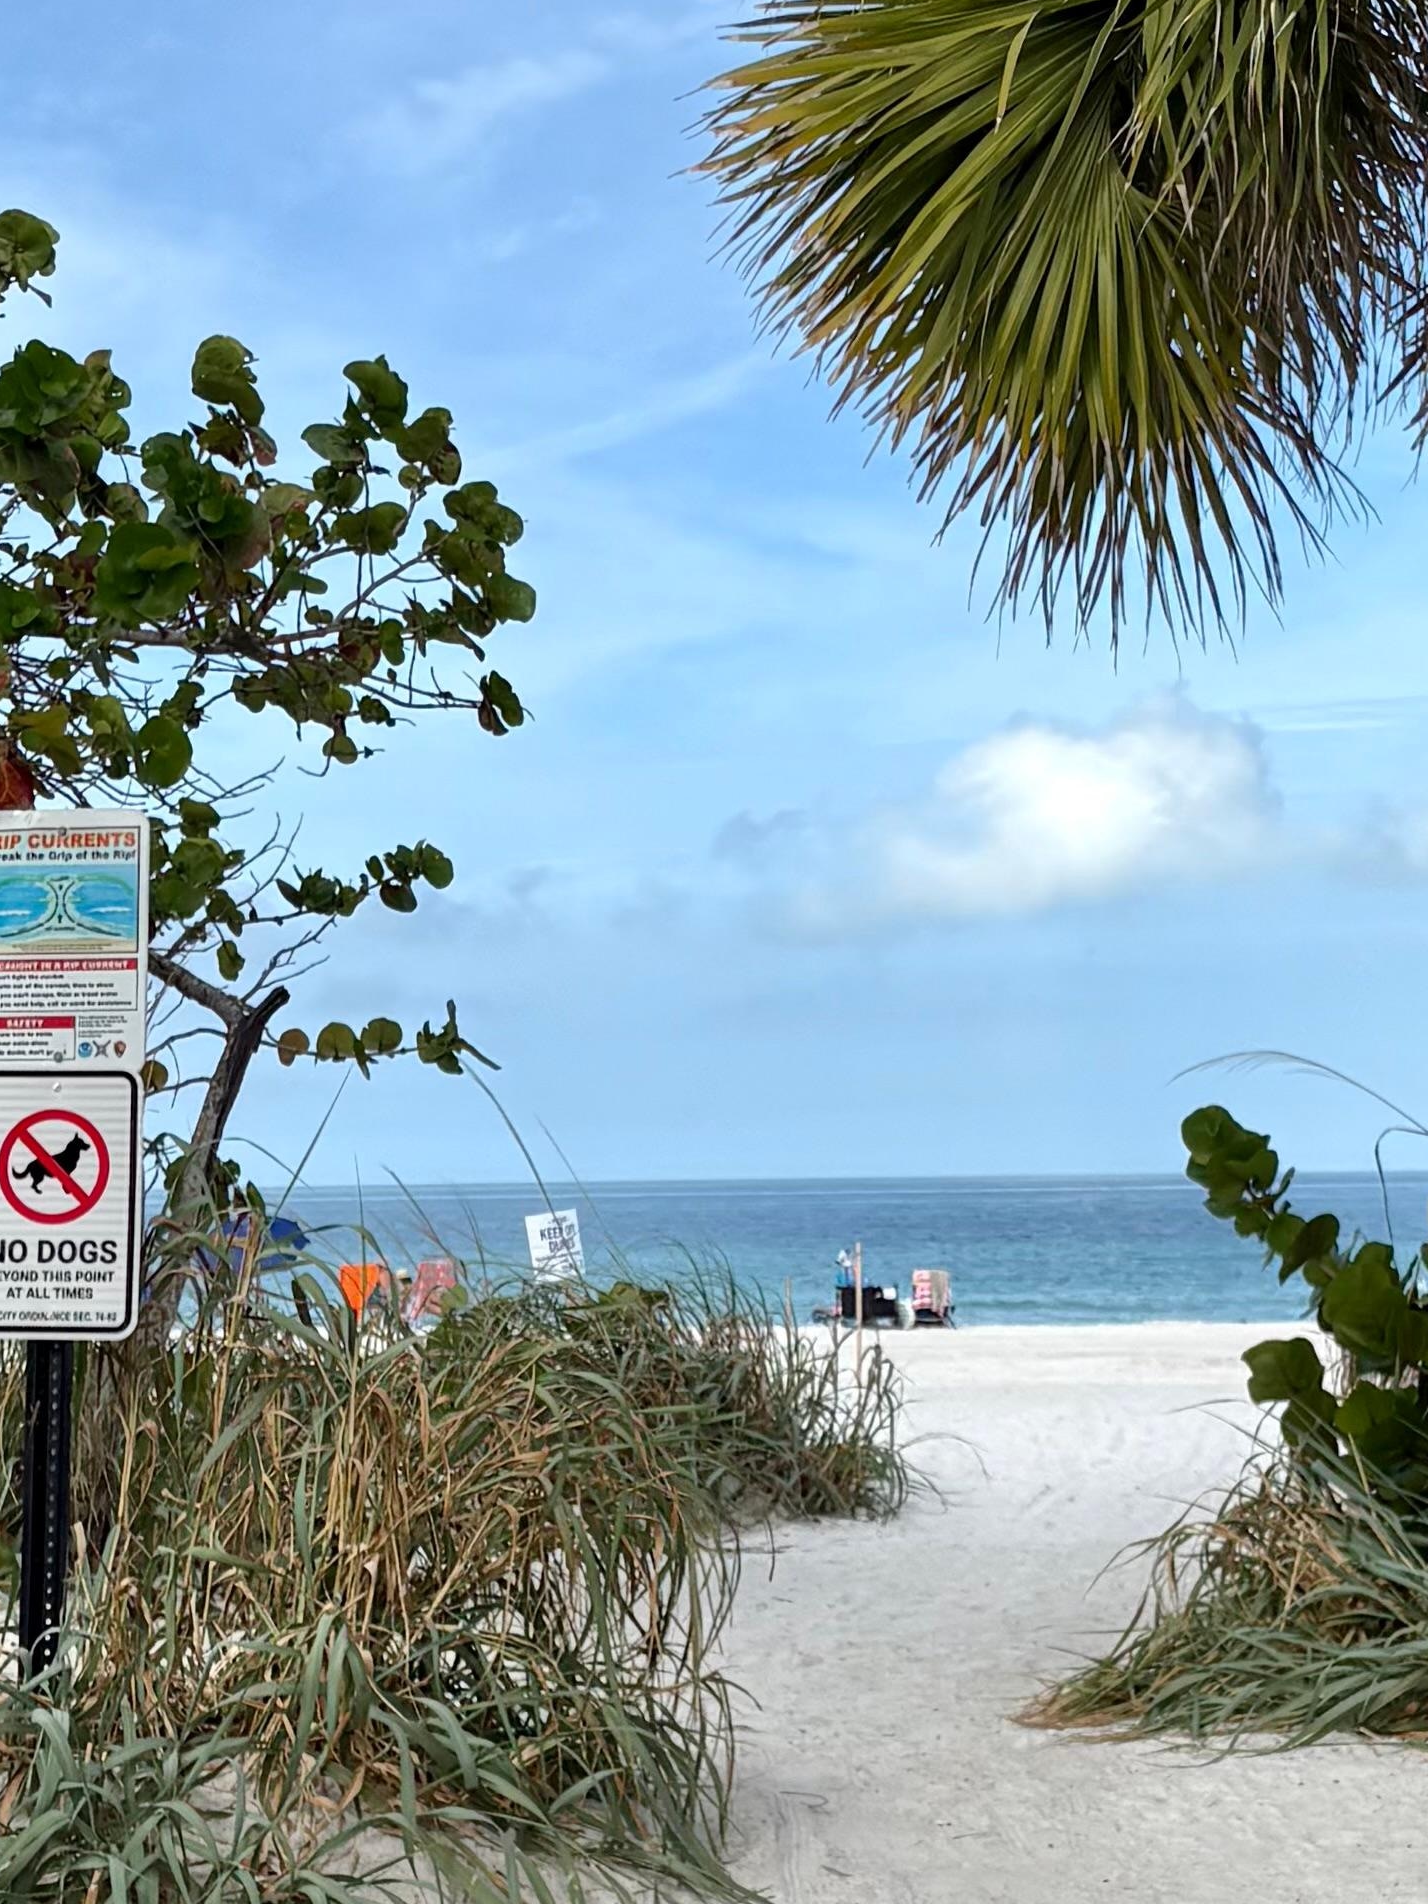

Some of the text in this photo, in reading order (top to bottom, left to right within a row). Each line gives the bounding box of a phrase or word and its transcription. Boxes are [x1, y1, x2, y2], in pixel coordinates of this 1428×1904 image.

[27, 831, 136, 849] CURRENTS
[26, 851, 44, 861] the
[48, 851, 72, 862] Grip
[76, 851, 88, 860] of
[91, 850, 109, 860] the
[6, 1019, 45, 1028] SAFETY
[37, 1239, 117, 1264] DOGS
[42, 1270, 72, 1282] THIS
[75, 1270, 115, 1283] POINT
[6, 1287, 94, 1299] AT ALL TIMES
[73, 1311, 92, 1321] SEC.
